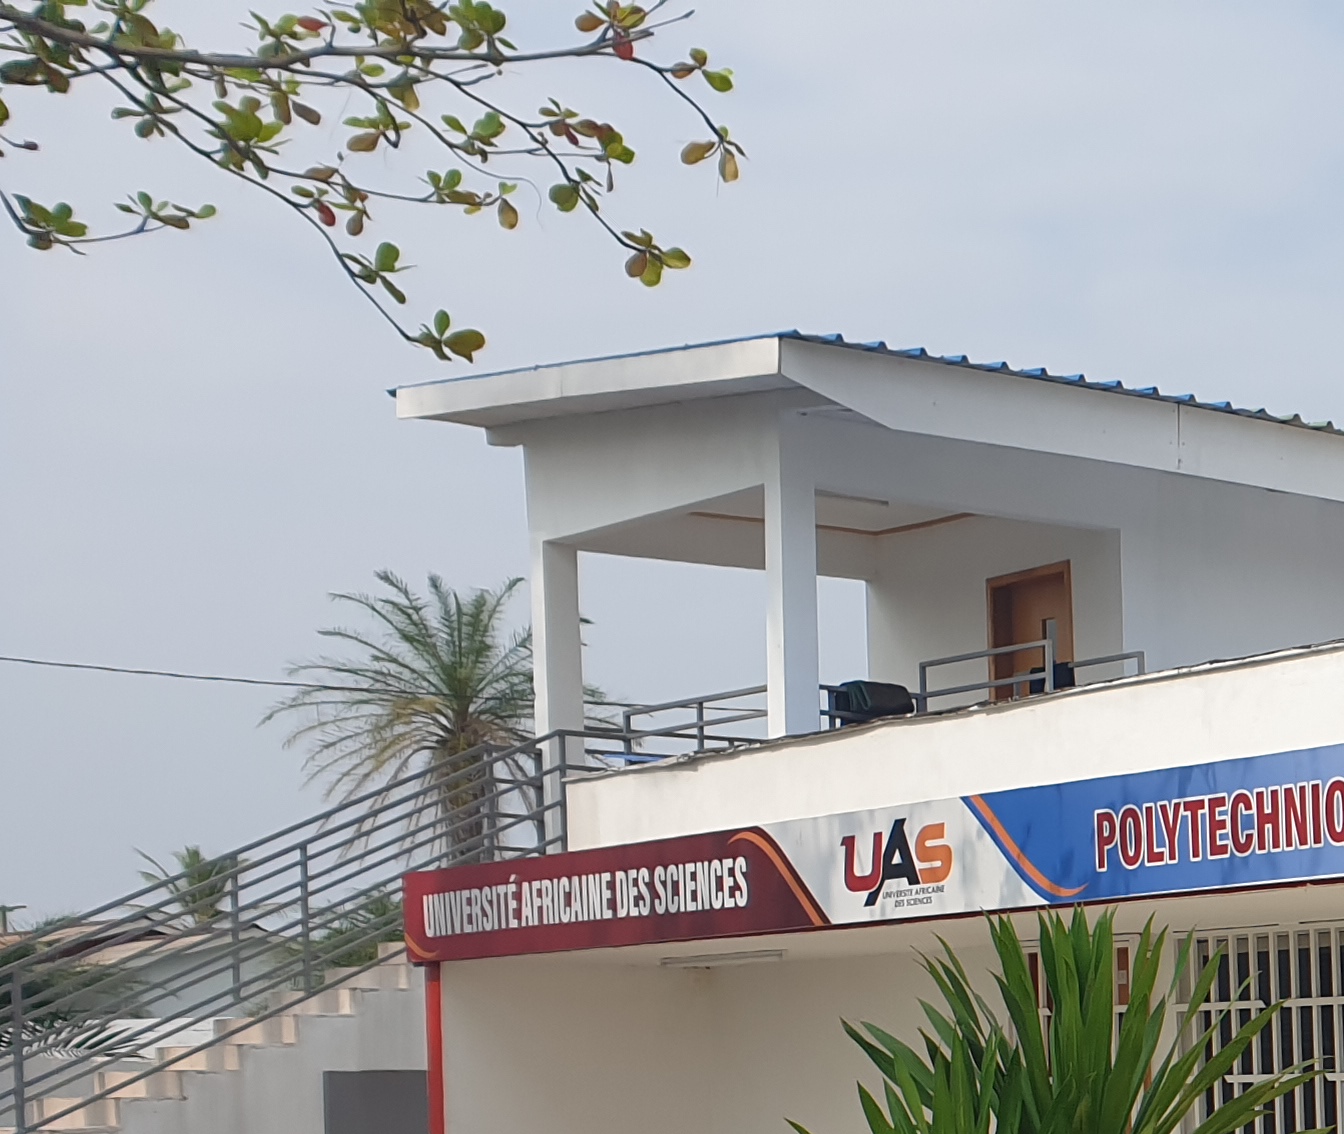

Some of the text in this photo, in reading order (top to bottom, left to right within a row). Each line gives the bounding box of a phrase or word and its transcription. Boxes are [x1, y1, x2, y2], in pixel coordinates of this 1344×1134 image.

[840, 817, 953, 907] UAS
[422, 856, 748, 938] UNIVERSITÉ AFRICAINE DES SCIENCES
[894, 896, 932, 907] DES SCIENCES
[914, 884, 945, 896] AFRICAINE
